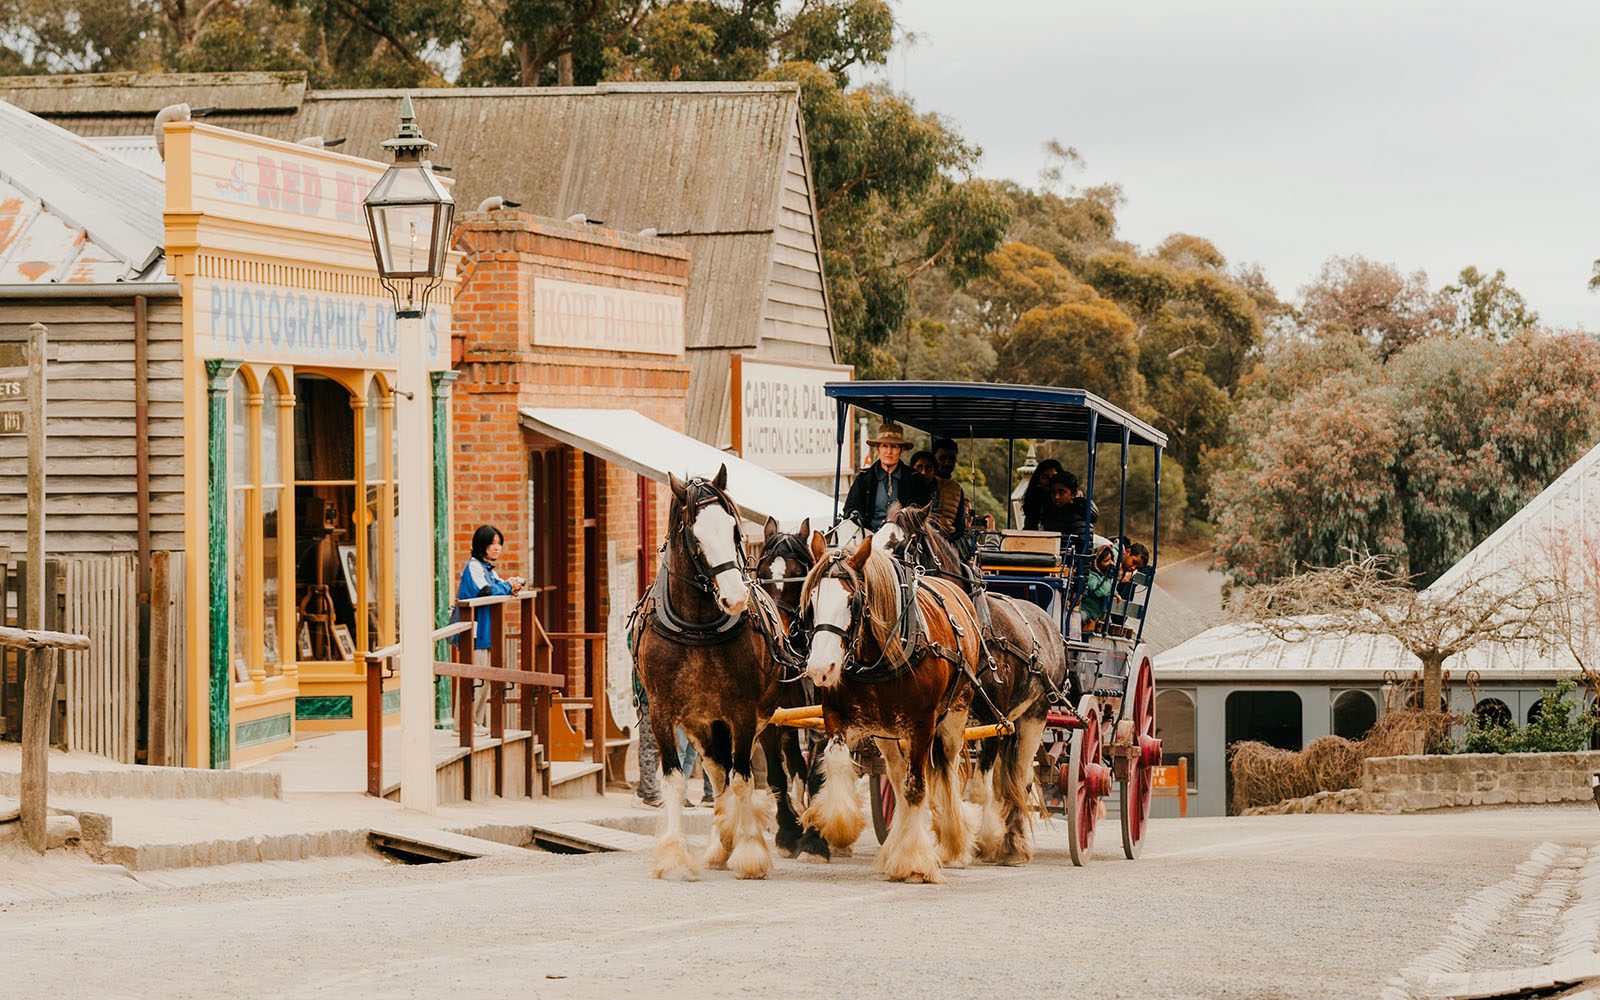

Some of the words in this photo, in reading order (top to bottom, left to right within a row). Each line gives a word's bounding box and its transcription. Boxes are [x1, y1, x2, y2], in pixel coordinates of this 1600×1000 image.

[257, 156, 321, 213] RED
[336, 171, 382, 223] HI
[211, 285, 369, 354] PHOTOGRAPHIC
[375, 301, 439, 358] ROS
[539, 287, 597, 339] HOPE
[745, 380, 790, 418] CARVER
[792, 386, 798, 418] &
[803, 384, 836, 420] DALTO
[747, 426, 783, 454] AUCTION
[786, 427, 791, 454] &
[794, 427, 813, 454] SALE
